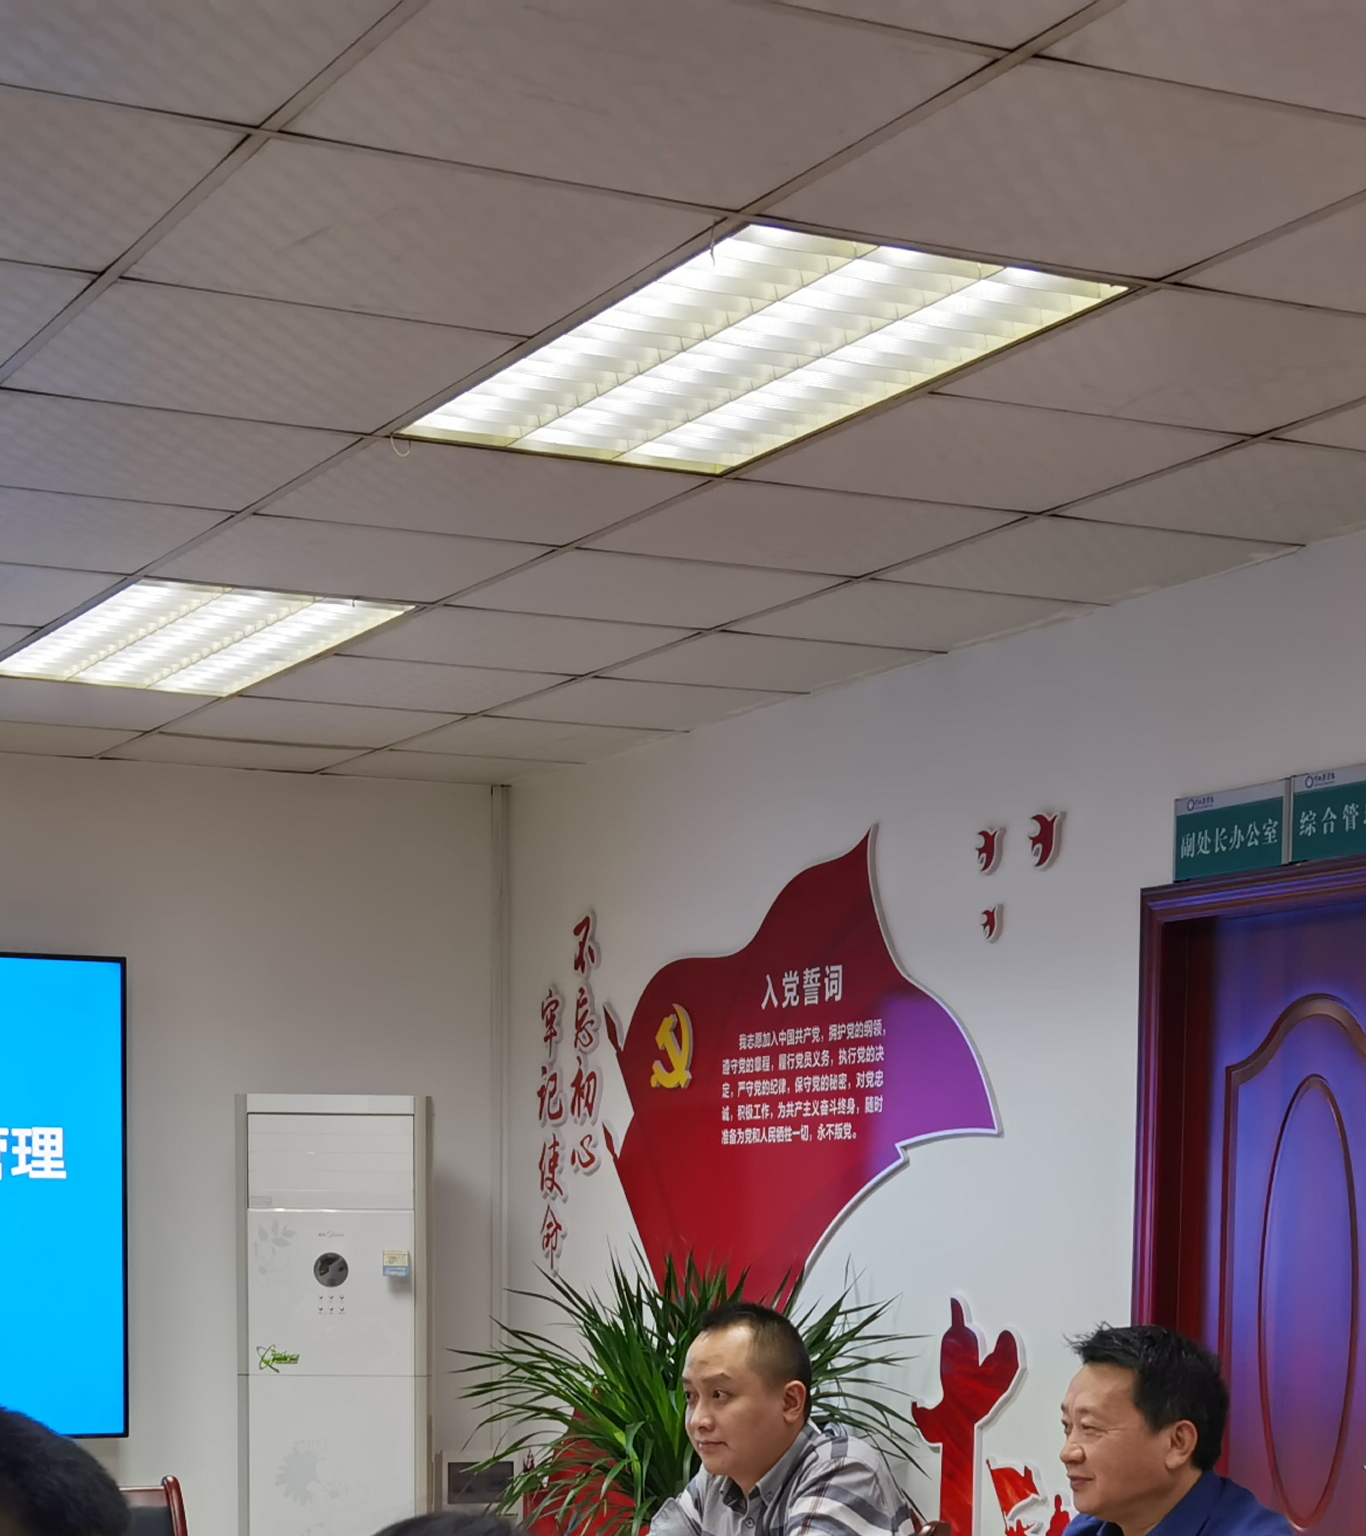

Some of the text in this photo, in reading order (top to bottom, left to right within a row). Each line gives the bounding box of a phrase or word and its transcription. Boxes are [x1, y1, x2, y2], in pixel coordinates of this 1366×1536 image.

[1180, 818, 1279, 859] 副处长办公室
[571, 916, 598, 1169] 不忘初心
[761, 964, 843, 1010] 入党誓词
[537, 988, 563, 1270] 牢记使命
